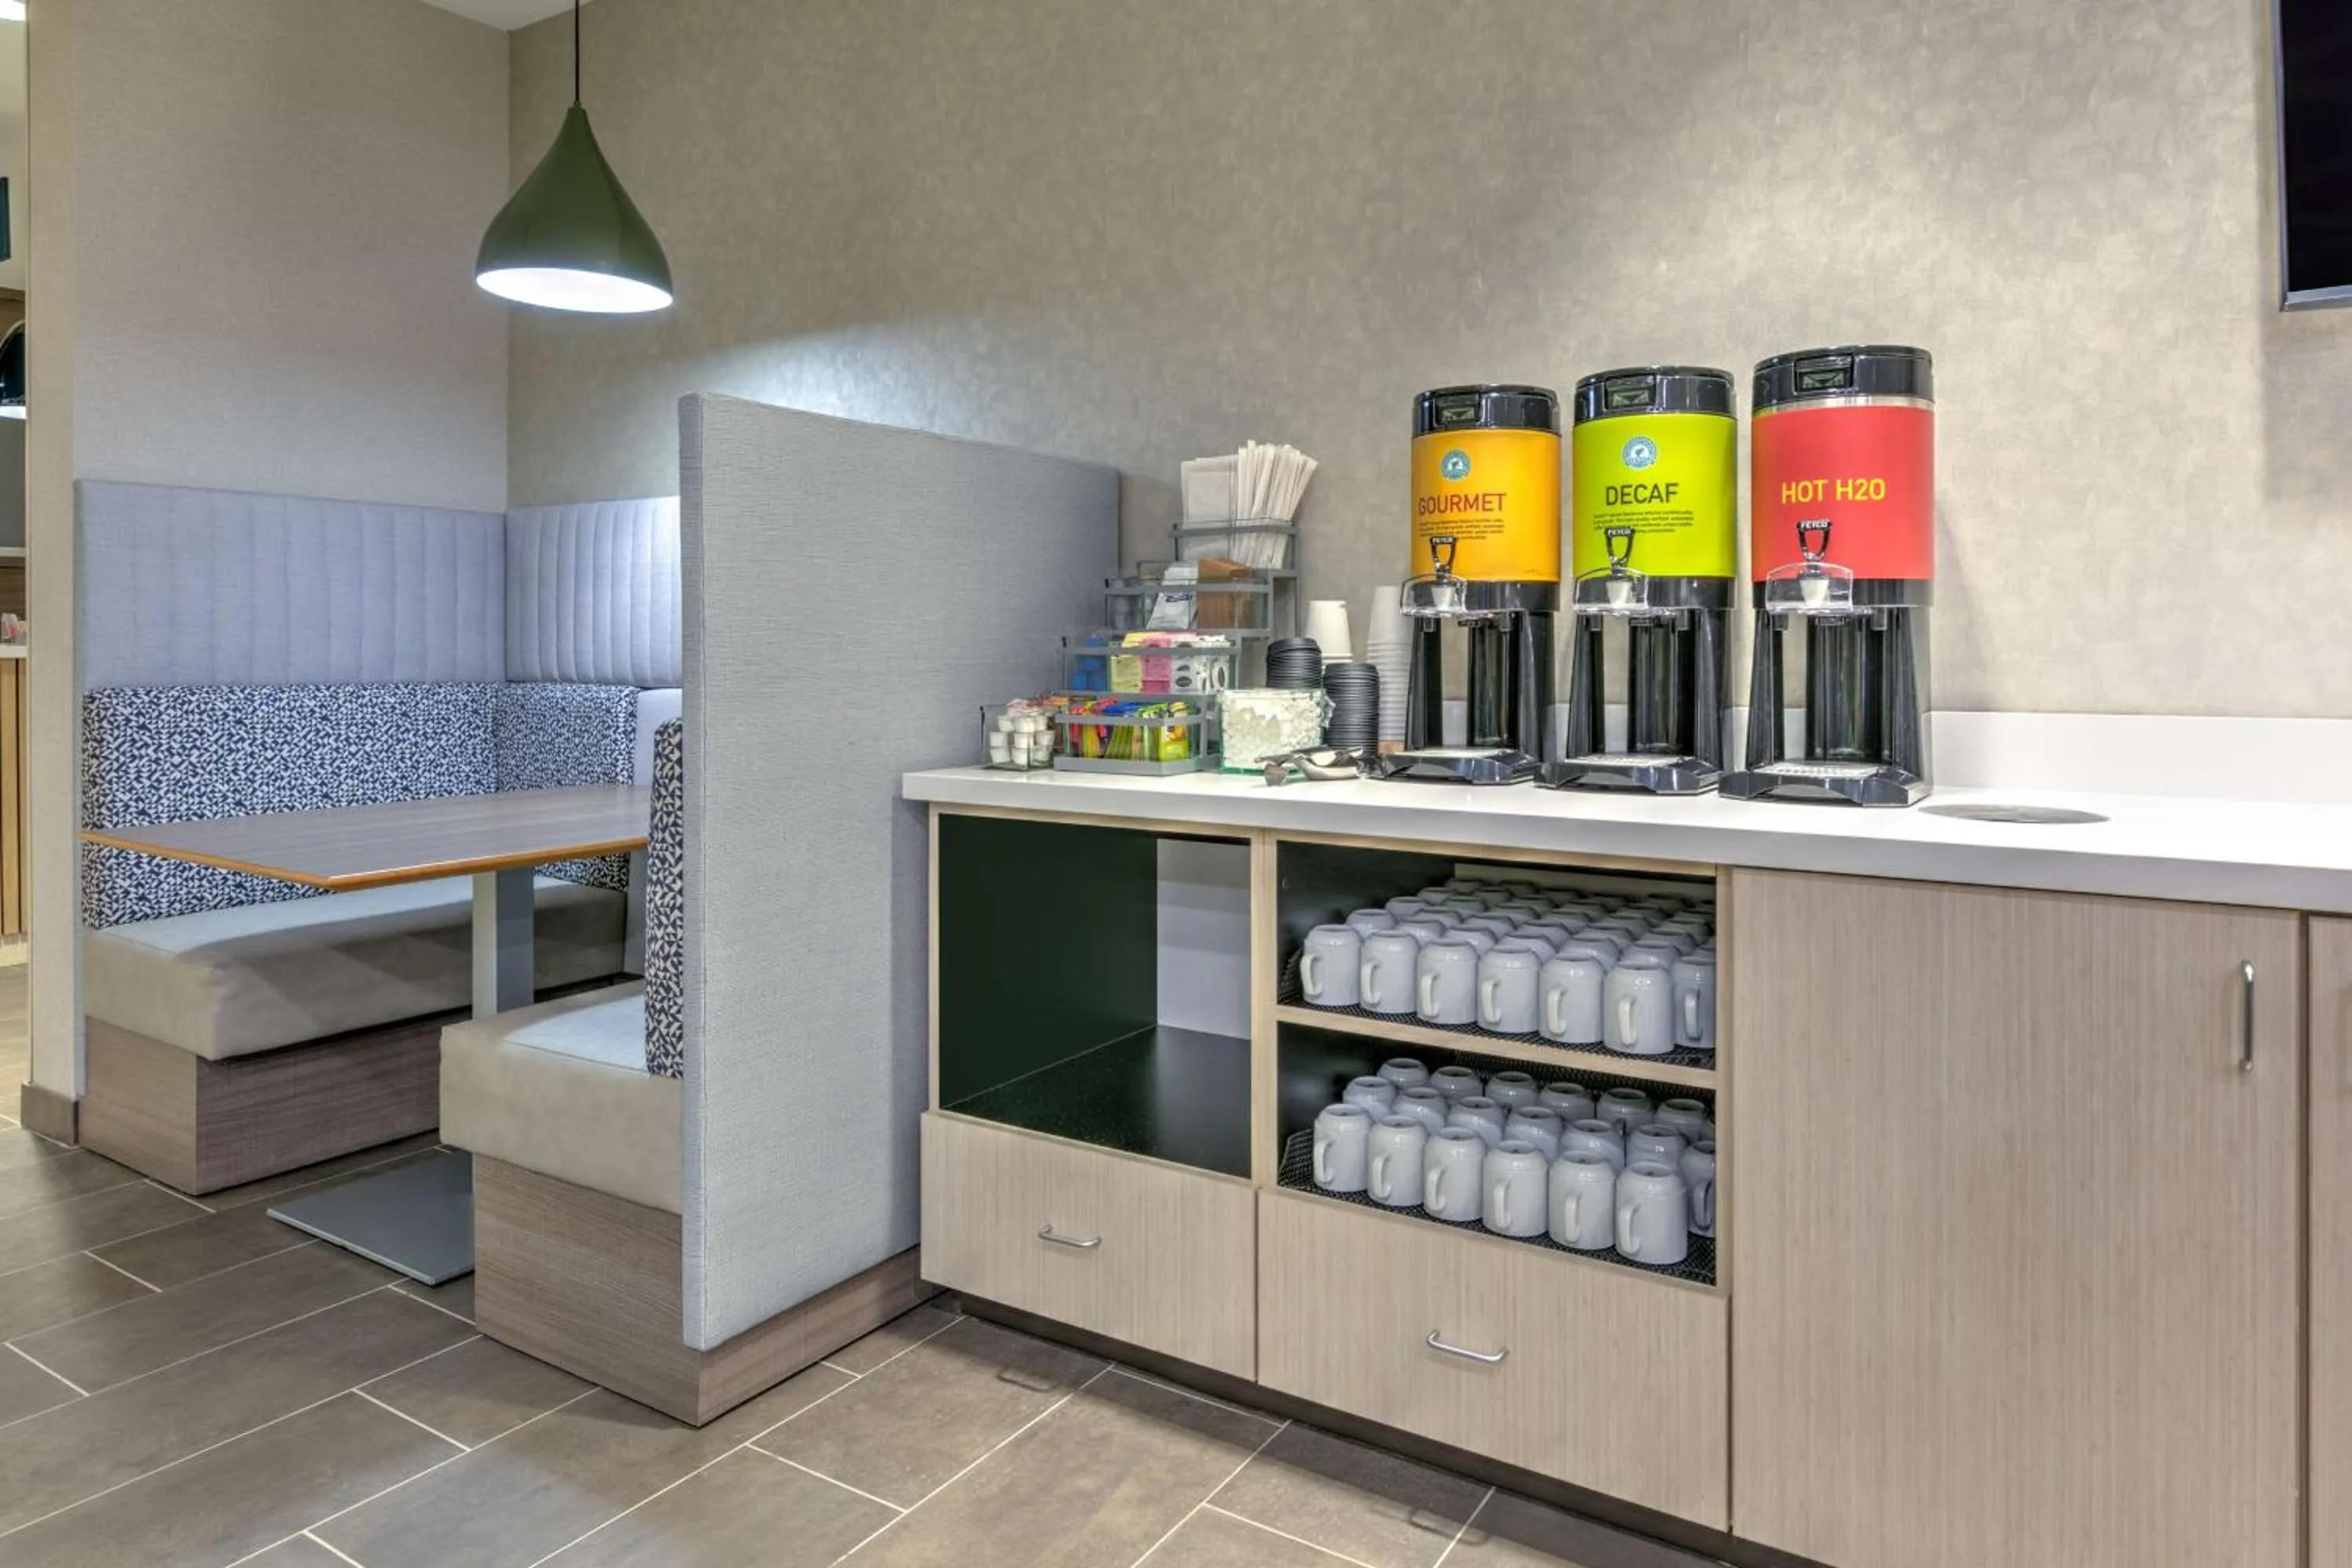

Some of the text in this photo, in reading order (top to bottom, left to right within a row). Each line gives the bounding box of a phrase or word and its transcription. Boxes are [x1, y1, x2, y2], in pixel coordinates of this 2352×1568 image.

[1418, 492, 1507, 515] GOURMET
[1606, 482, 1679, 506] DECAF
[1781, 479, 1829, 504] HOT
